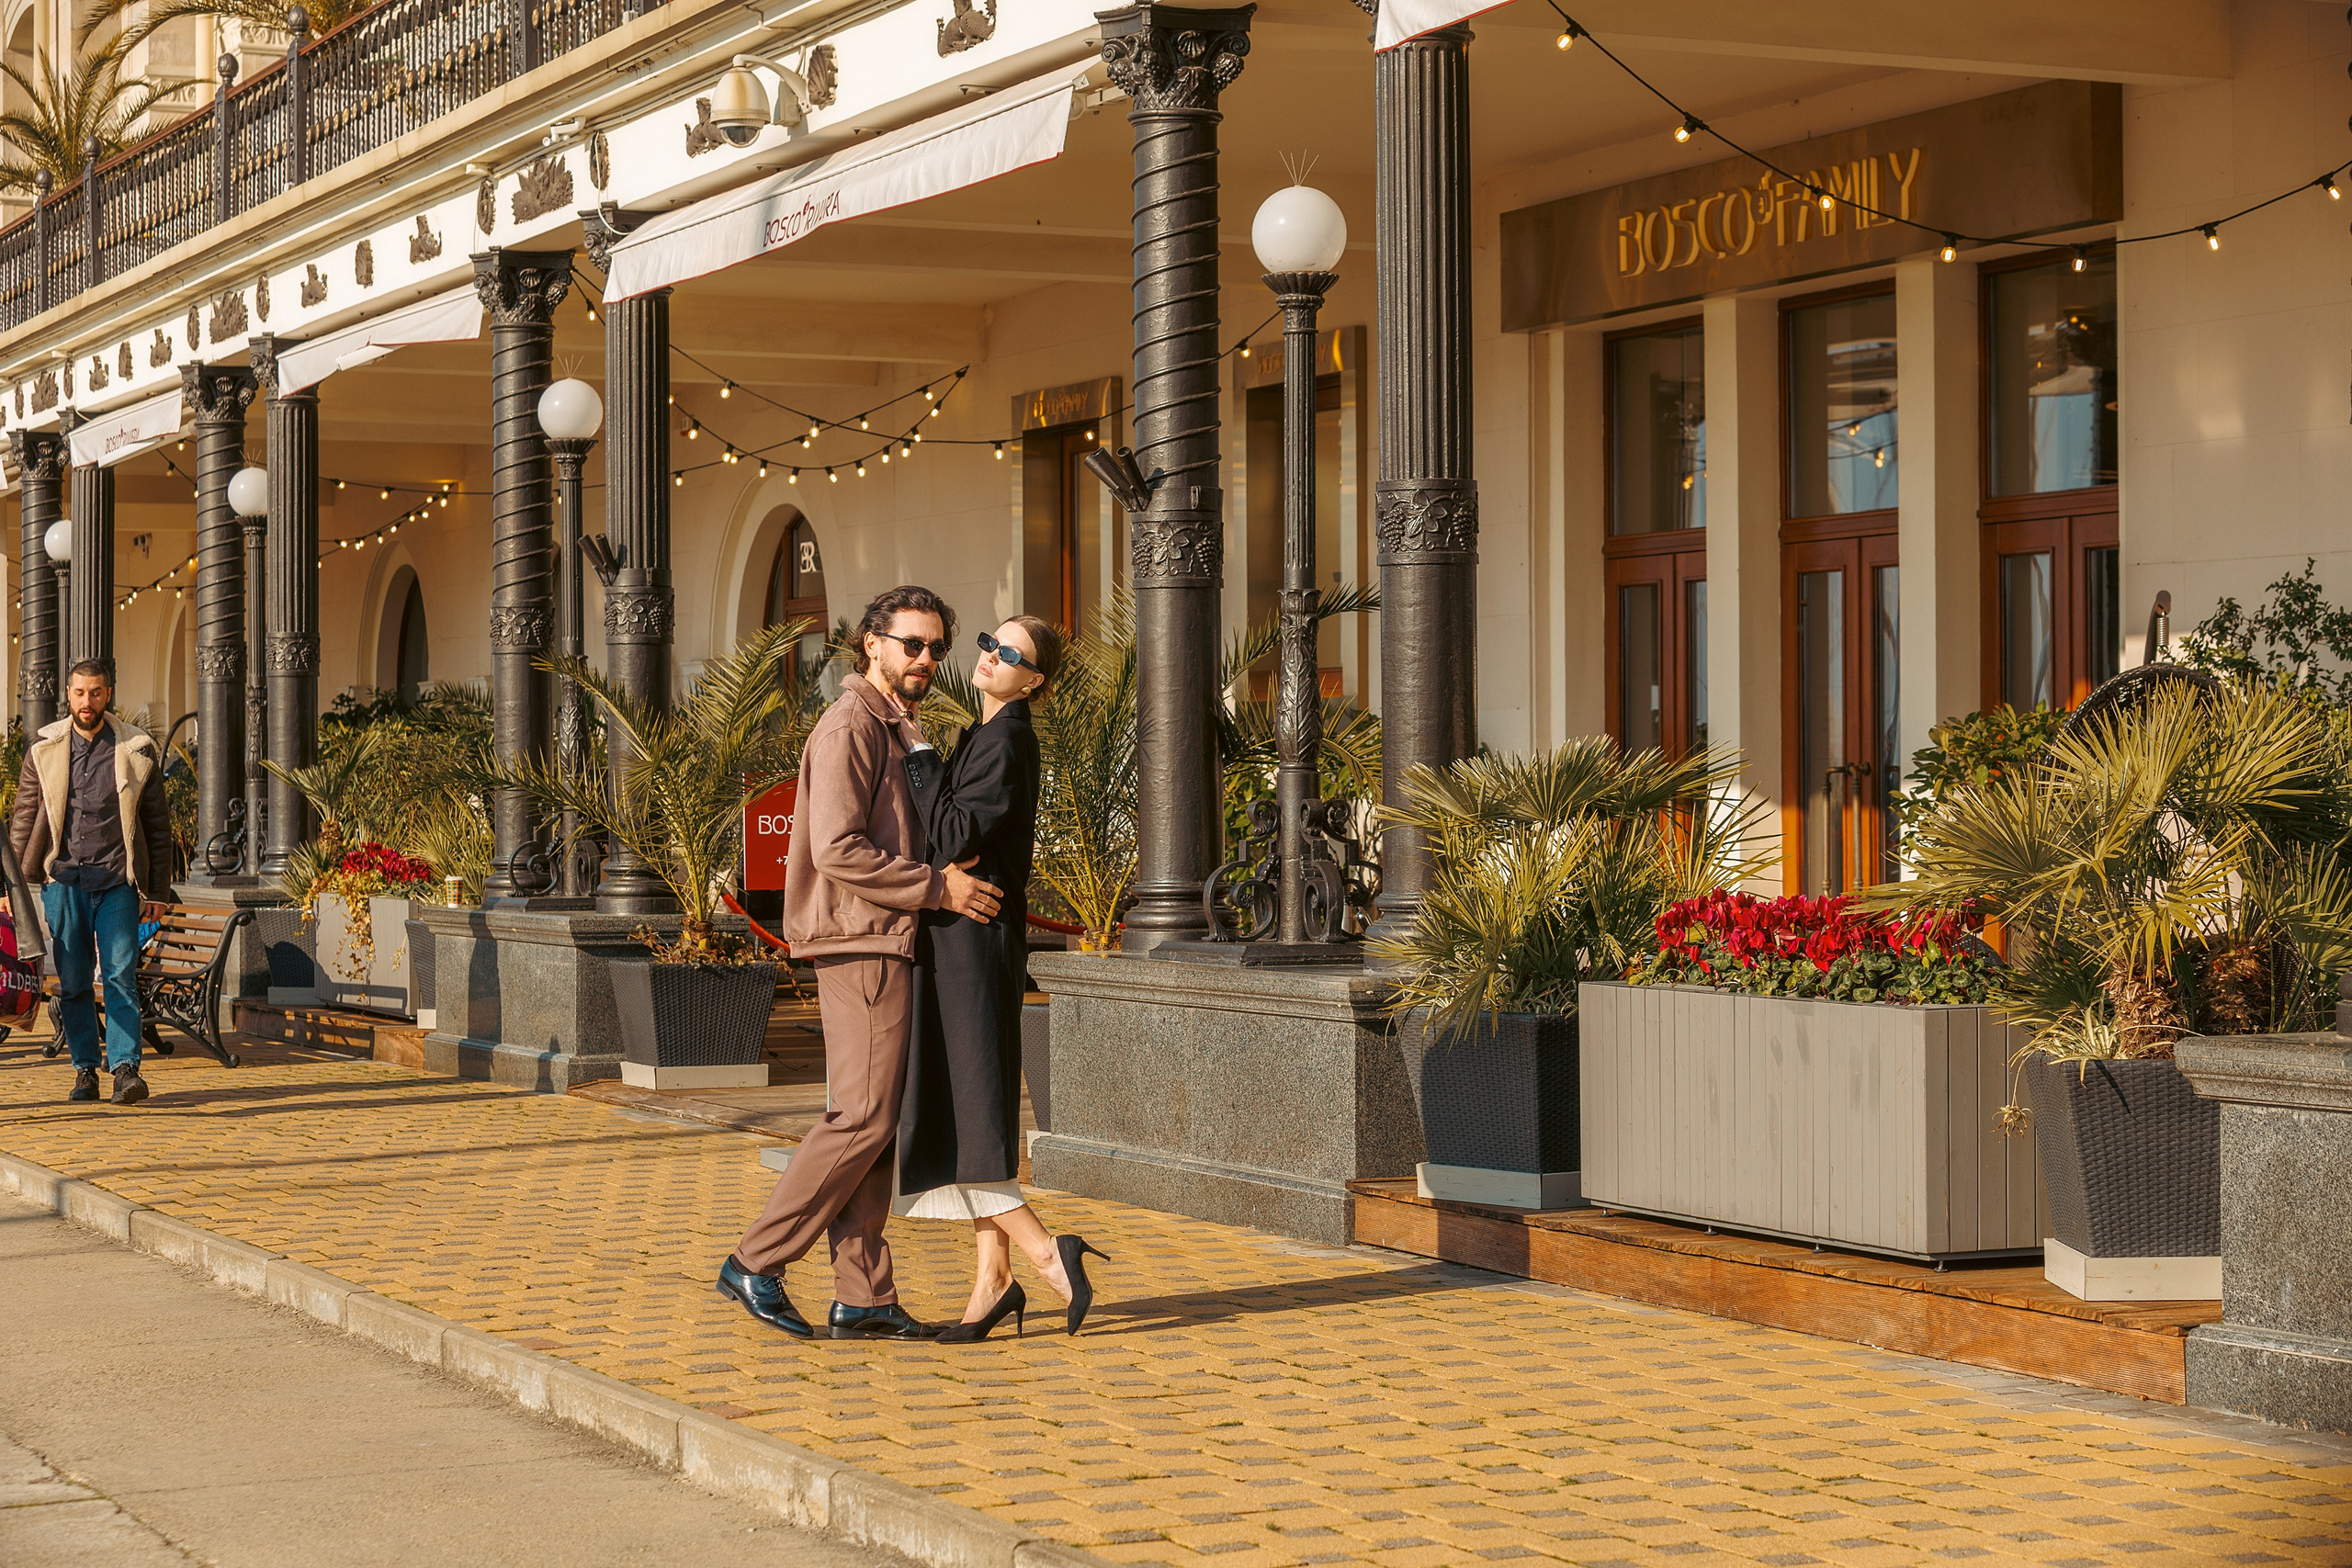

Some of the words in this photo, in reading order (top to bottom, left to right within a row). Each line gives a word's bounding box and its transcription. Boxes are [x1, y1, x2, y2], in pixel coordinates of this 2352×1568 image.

[763, 210, 801, 248] BOSCO
[1619, 187, 1756, 277] BOSCO
[1777, 148, 1921, 246] FAMILY
